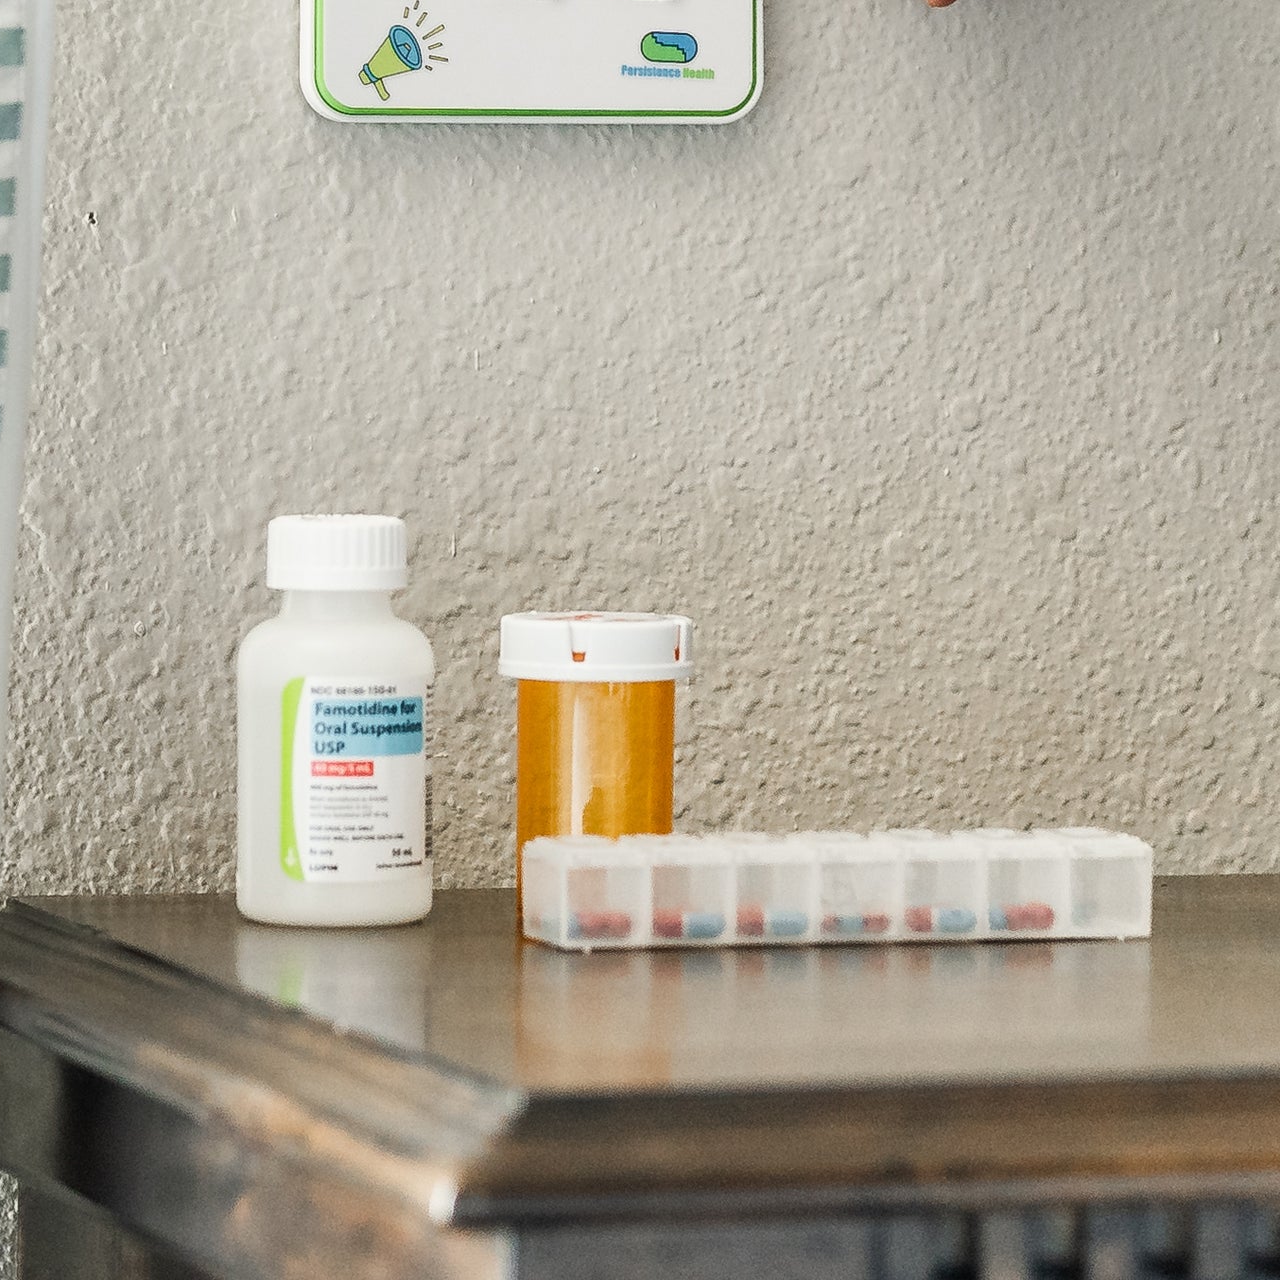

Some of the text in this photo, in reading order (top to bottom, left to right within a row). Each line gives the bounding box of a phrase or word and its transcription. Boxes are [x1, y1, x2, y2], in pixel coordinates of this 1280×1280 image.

[682, 67, 715, 80] Health
[314, 700, 417, 716] Famotidine for
[314, 720, 347, 735] Oral
[314, 740, 346, 754] USP
